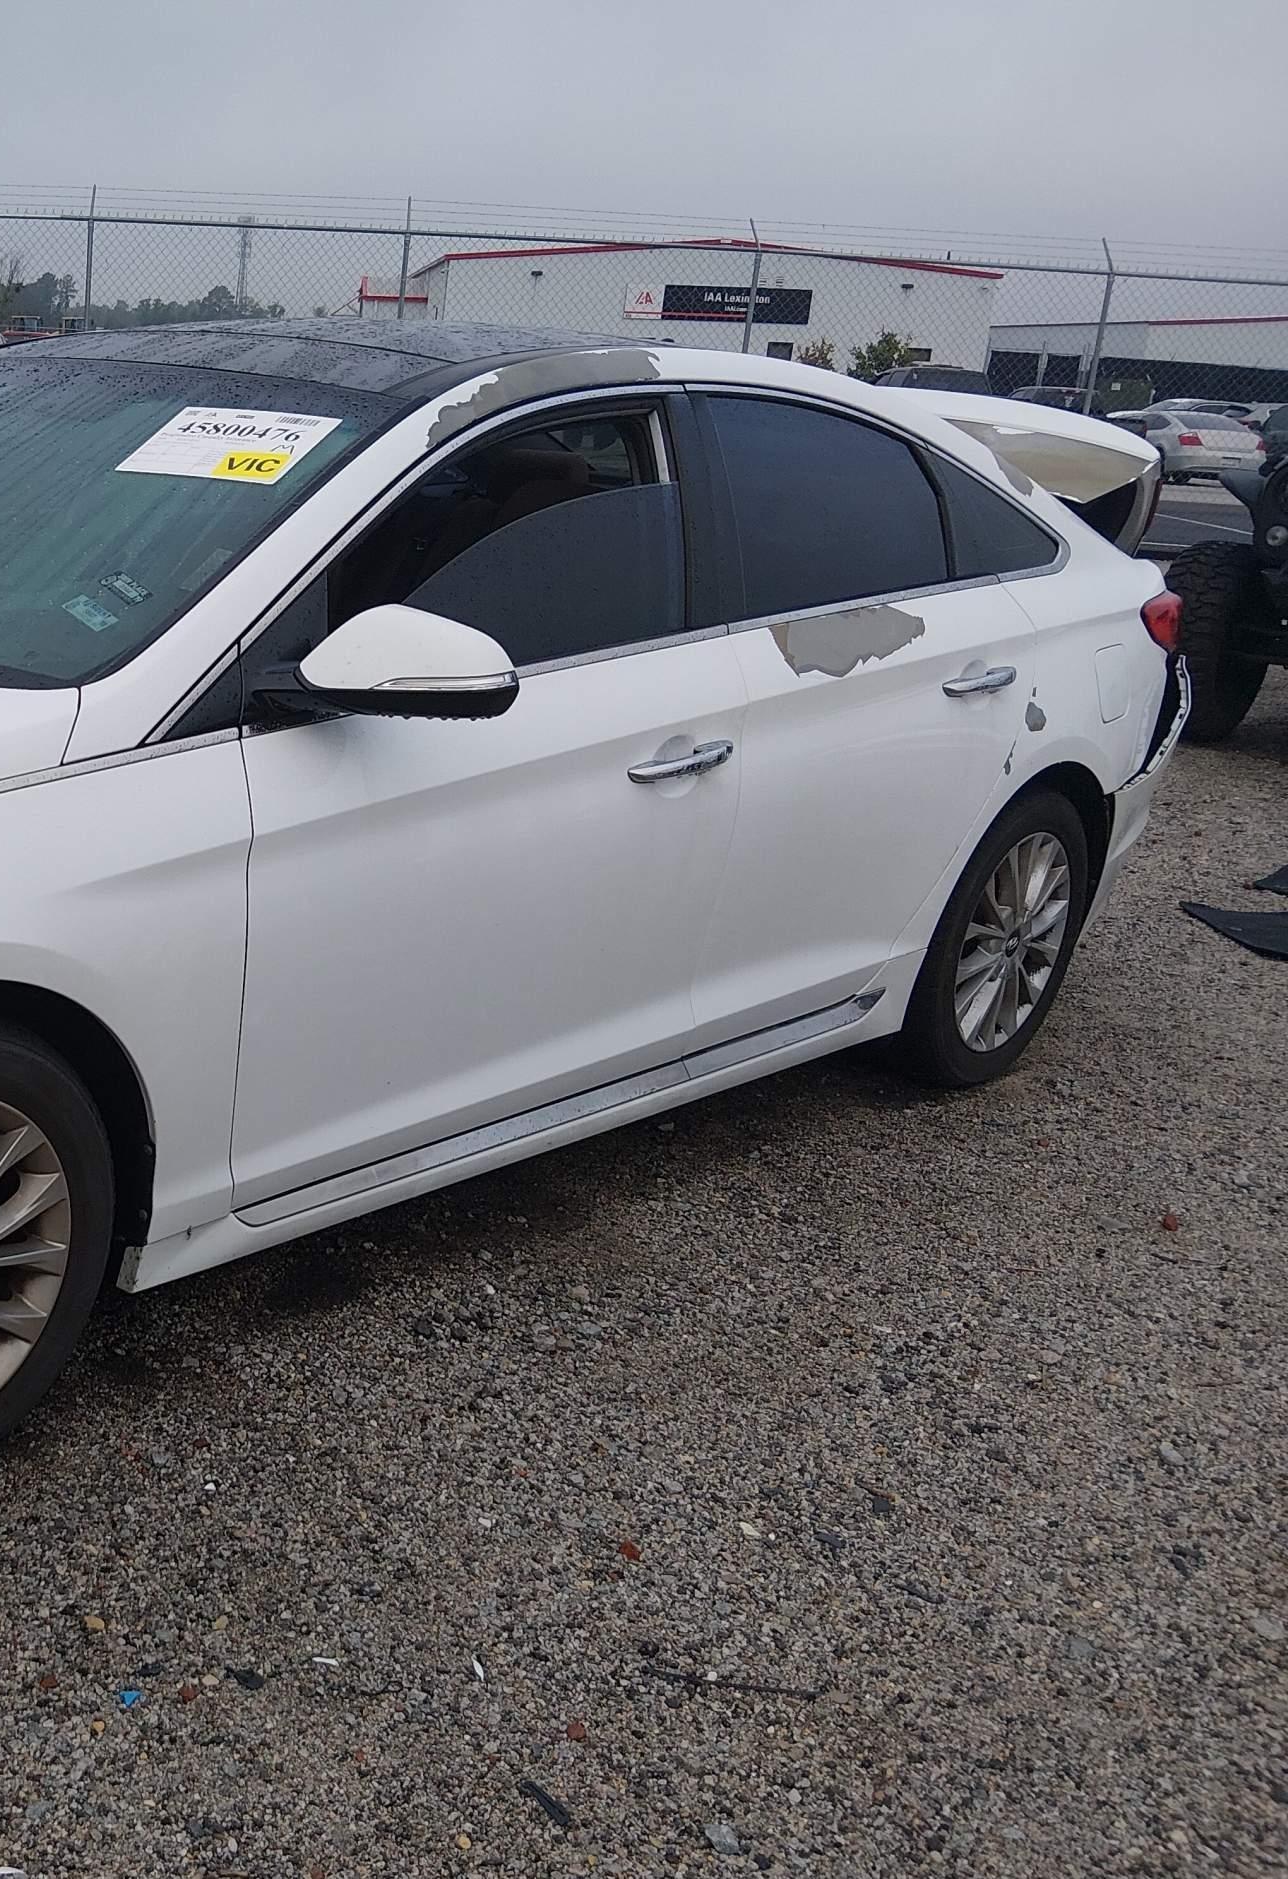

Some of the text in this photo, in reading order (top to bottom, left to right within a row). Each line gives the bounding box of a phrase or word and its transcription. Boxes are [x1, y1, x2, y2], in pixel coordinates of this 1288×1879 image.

[703, 292, 771, 304] IAA Lexinton
[177, 420, 307, 443] 45800476
[227, 457, 281, 473] VIC
